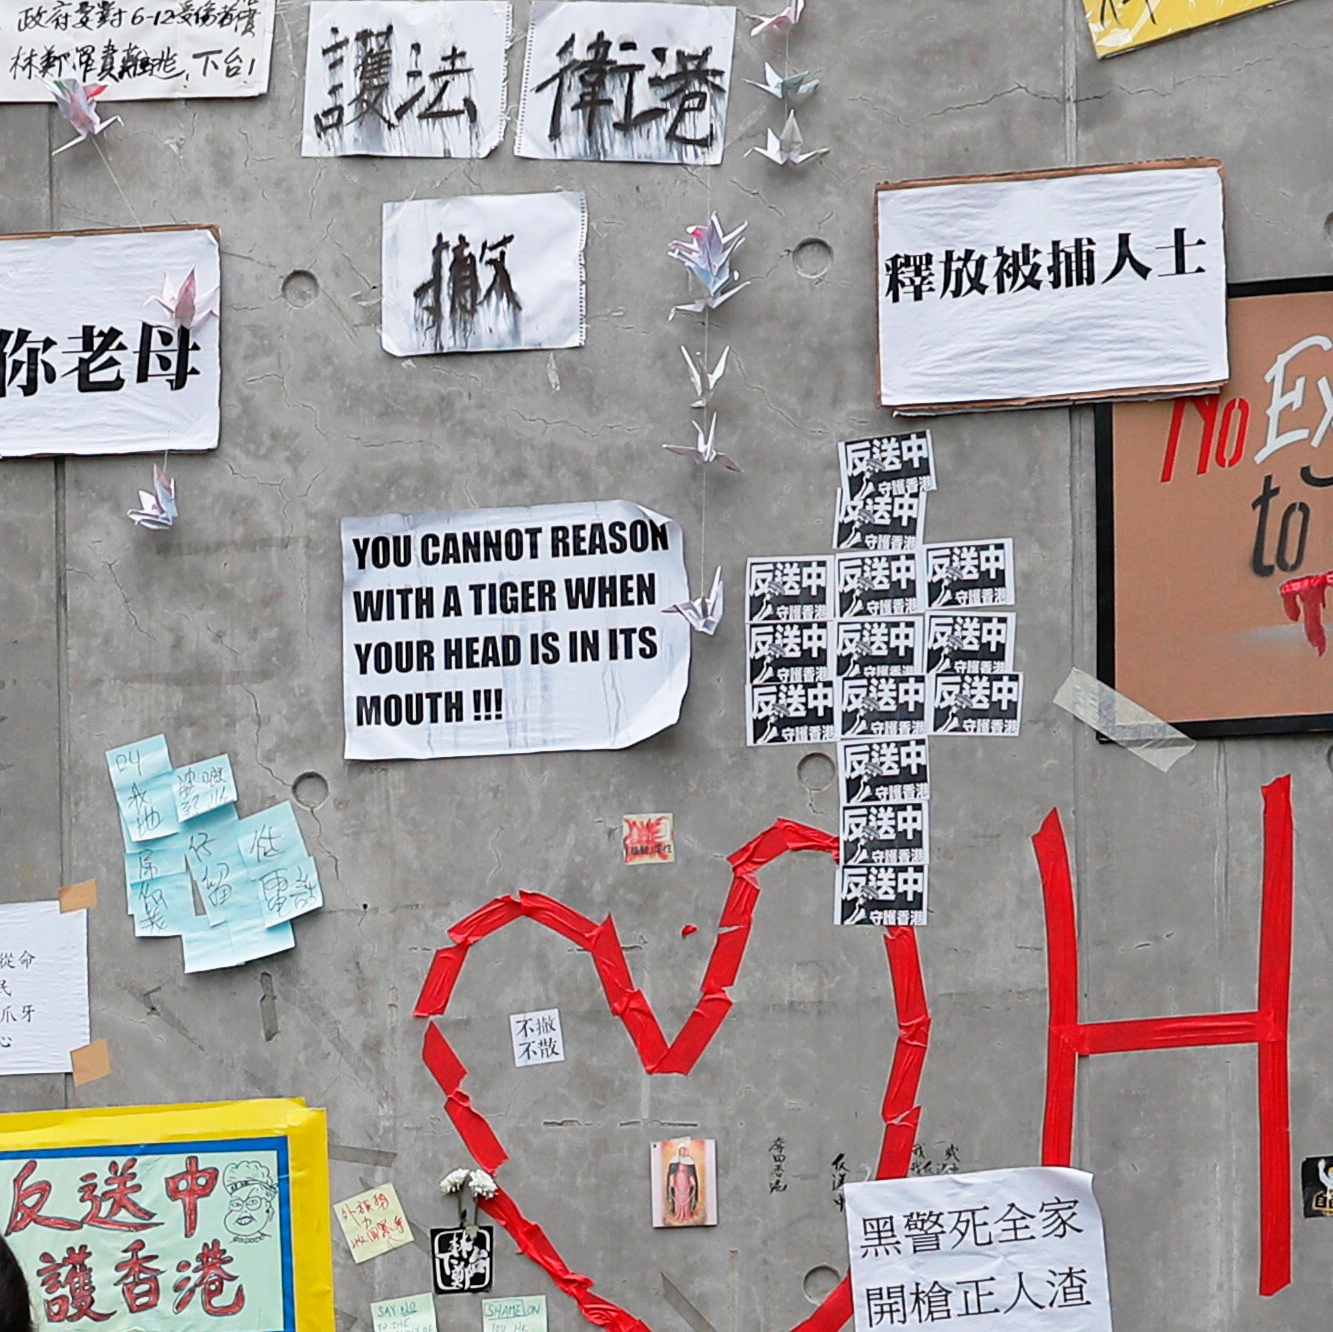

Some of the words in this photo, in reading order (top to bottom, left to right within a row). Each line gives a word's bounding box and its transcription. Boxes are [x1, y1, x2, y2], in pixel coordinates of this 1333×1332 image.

[314, 25, 475, 140] 護法
[883, 227, 1208, 304] 釋放被捕人士
[845, 433, 929, 478] 反送中
[839, 495, 919, 526] 反送中
[1251, 474, 1311, 578] to
[353, 534, 412, 571] YOU
[420, 526, 543, 567] CANNOT
[550, 519, 670, 558] REASON
[353, 586, 435, 622] WITH
[442, 585, 463, 617] A
[468, 579, 557, 615] TIGER
[564, 572, 657, 610] WHEN
[354, 640, 435, 675] YOUR
[444, 634, 522, 671] HEAD
[530, 631, 560, 665] IS
[569, 630, 600, 663] IN
[608, 626, 659, 661] ITS
[356, 690, 464, 727] MOUTH
[472, 688, 504, 721] !!!
[516, 1014, 557, 1038] 不撤
[518, 1037, 560, 1062] 不散
[5, 1156, 219, 1238] 反送中
[860, 1195, 1085, 1259] 黑警死全家
[36, 1239, 246, 1323] 護香港
[865, 1266, 1092, 1328] 開槍正人渣
[486, 1304, 524, 1317] SHAME
